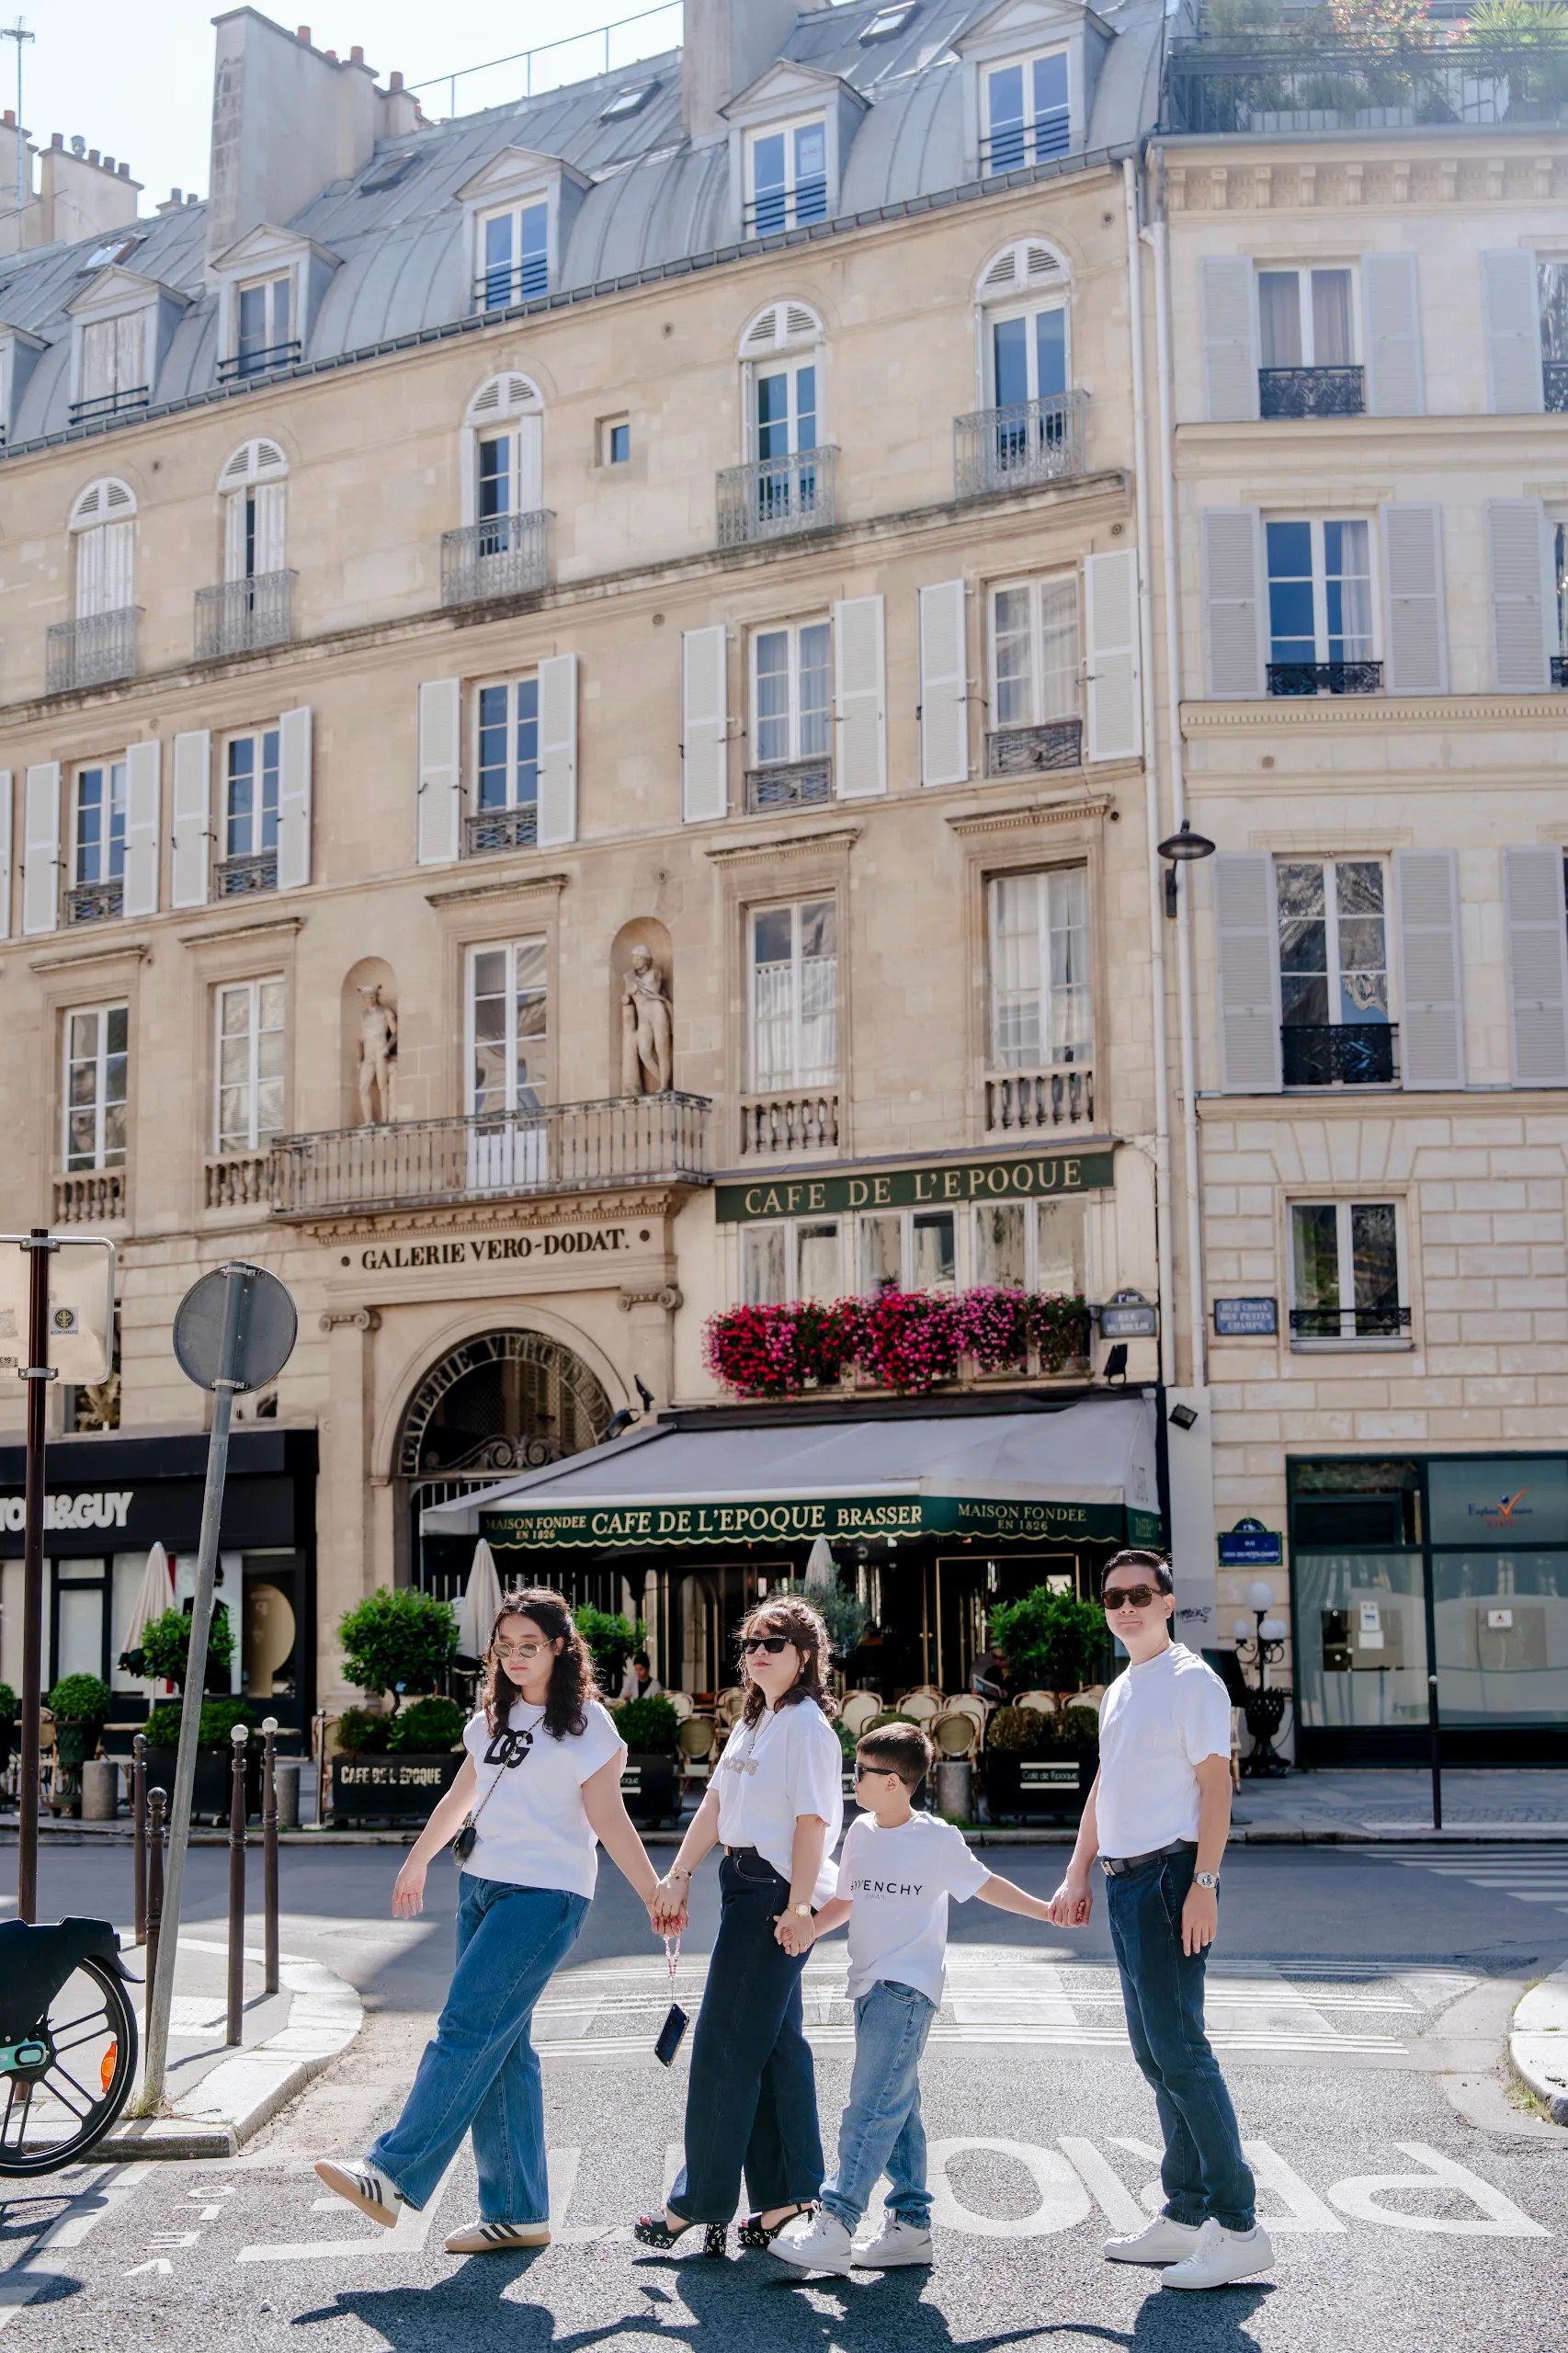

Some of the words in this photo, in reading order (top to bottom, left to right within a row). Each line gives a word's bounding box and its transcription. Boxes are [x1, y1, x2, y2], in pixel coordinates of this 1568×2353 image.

[744, 1183, 825, 1214] CAFE
[848, 1177, 892, 1205] DE
[915, 1159, 1082, 1199] L'EPOQUE
[362, 1243, 465, 1269] GALERIE
[591, 1513, 652, 1535] CAFE
[656, 1511, 691, 1532] DE
[698, 1506, 825, 1531] L'EPOQUE
[958, 1503, 1019, 1519] MAISON
[1024, 1506, 1086, 1522] FONDEE
[486, 1518, 534, 1530] MAISON
[536, 1517, 586, 1529] FONDEE
[998, 1519, 1014, 1529] EN
[1019, 1520, 1048, 1530] 1826
[516, 1531, 528, 1540] EN
[483, 1728, 533, 1768] DG
[341, 1766, 369, 1783] CAFE
